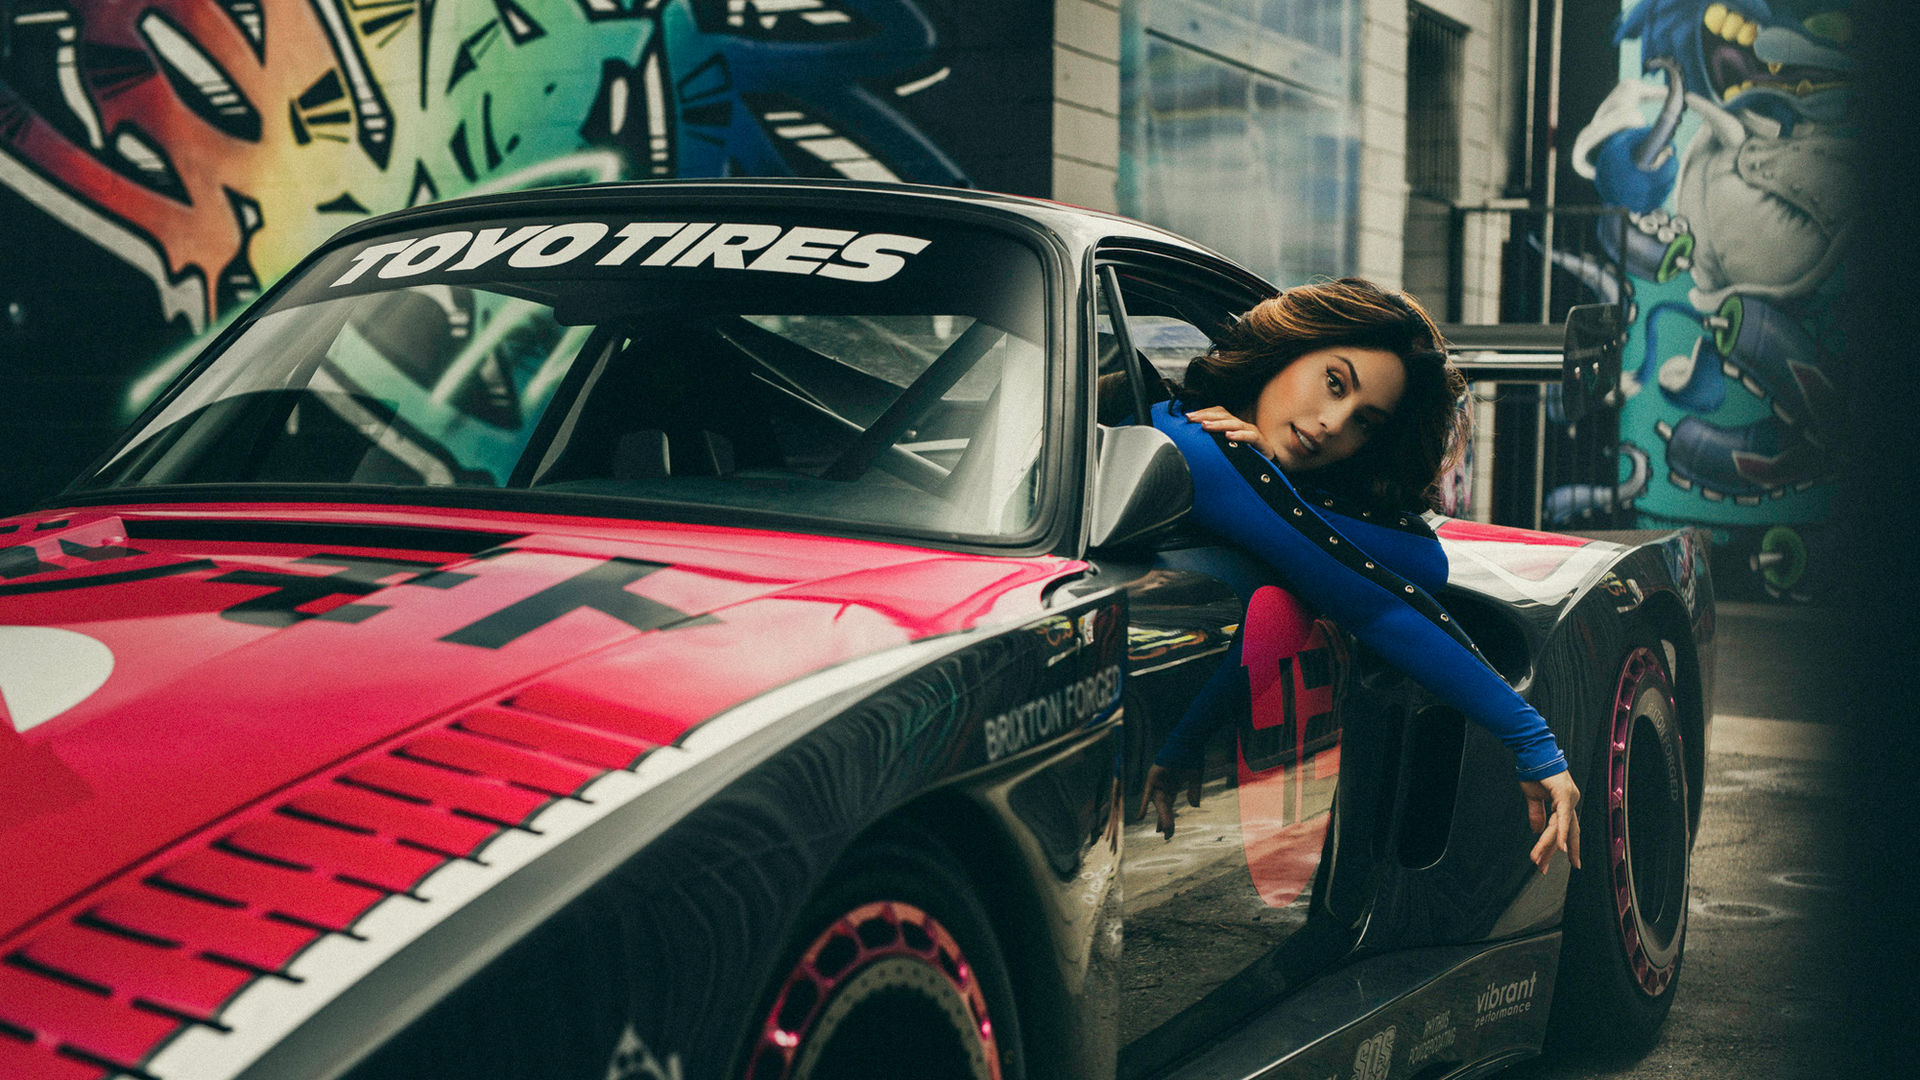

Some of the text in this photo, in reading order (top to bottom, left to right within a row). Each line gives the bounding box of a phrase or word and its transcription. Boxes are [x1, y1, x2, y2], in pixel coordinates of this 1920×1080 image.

[328, 222, 933, 288] TOYO TIRES
[984, 691, 1063, 761] BRIXTON
[1474, 1002, 1532, 1032] performance
[1477, 971, 1537, 1014] vibrant
